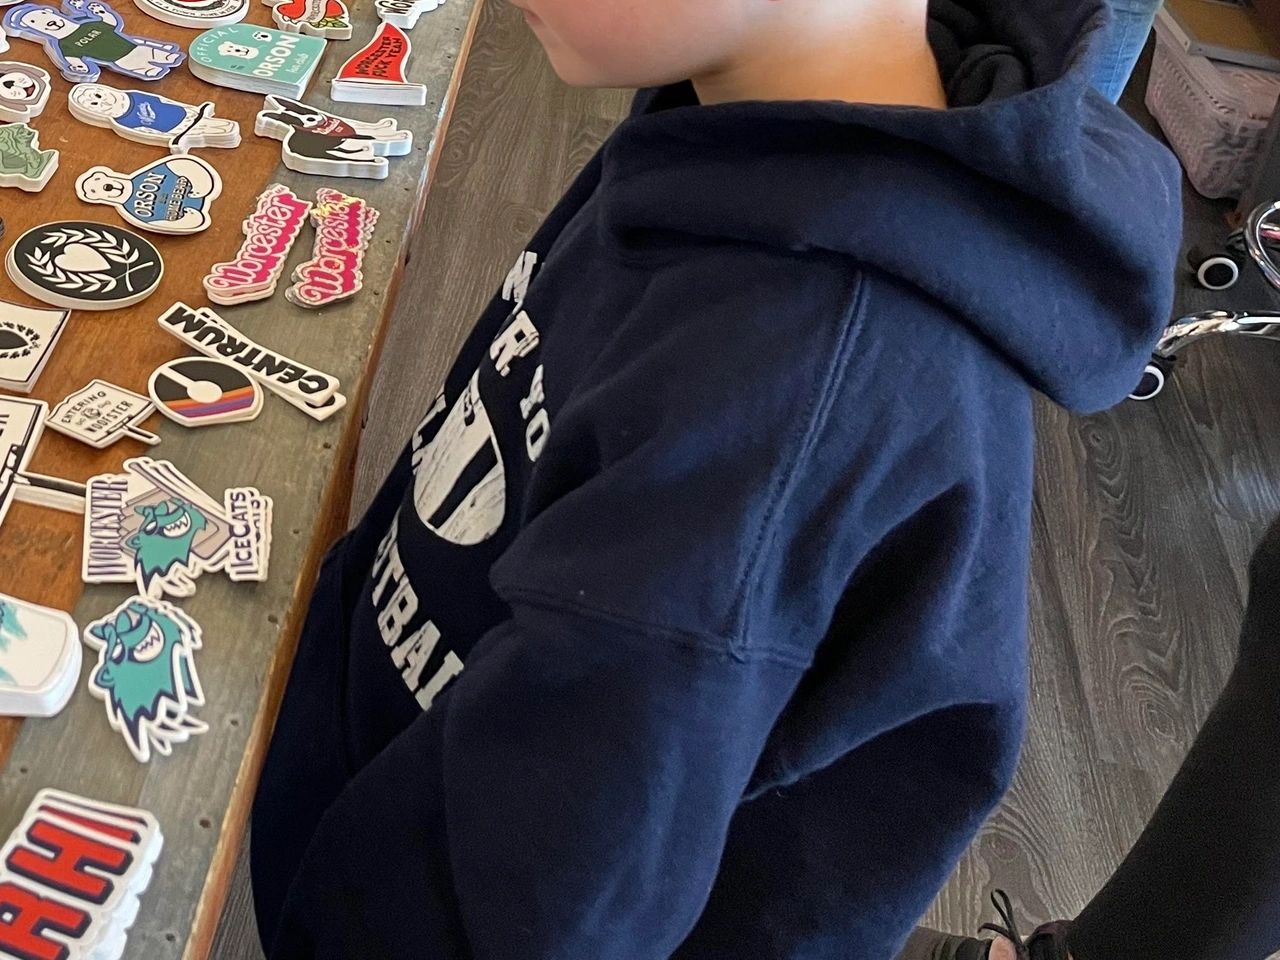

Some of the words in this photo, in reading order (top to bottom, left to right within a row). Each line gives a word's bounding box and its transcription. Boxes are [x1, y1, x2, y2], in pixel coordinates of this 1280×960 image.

[74, 28, 102, 48] POLAR
[196, 26, 239, 63] OFFICIAL
[252, 34, 300, 78] ORSON
[355, 36, 392, 76] WORCESTER
[373, 53, 394, 78] FUCK
[386, 37, 404, 58] YEAH
[134, 172, 167, 218] ORSON
[208, 192, 297, 288] Worcester
[168, 306, 330, 394] CENTRUM
[61, 390, 107, 424] ENTERING
[88, 478, 129, 577] WORCESTER
